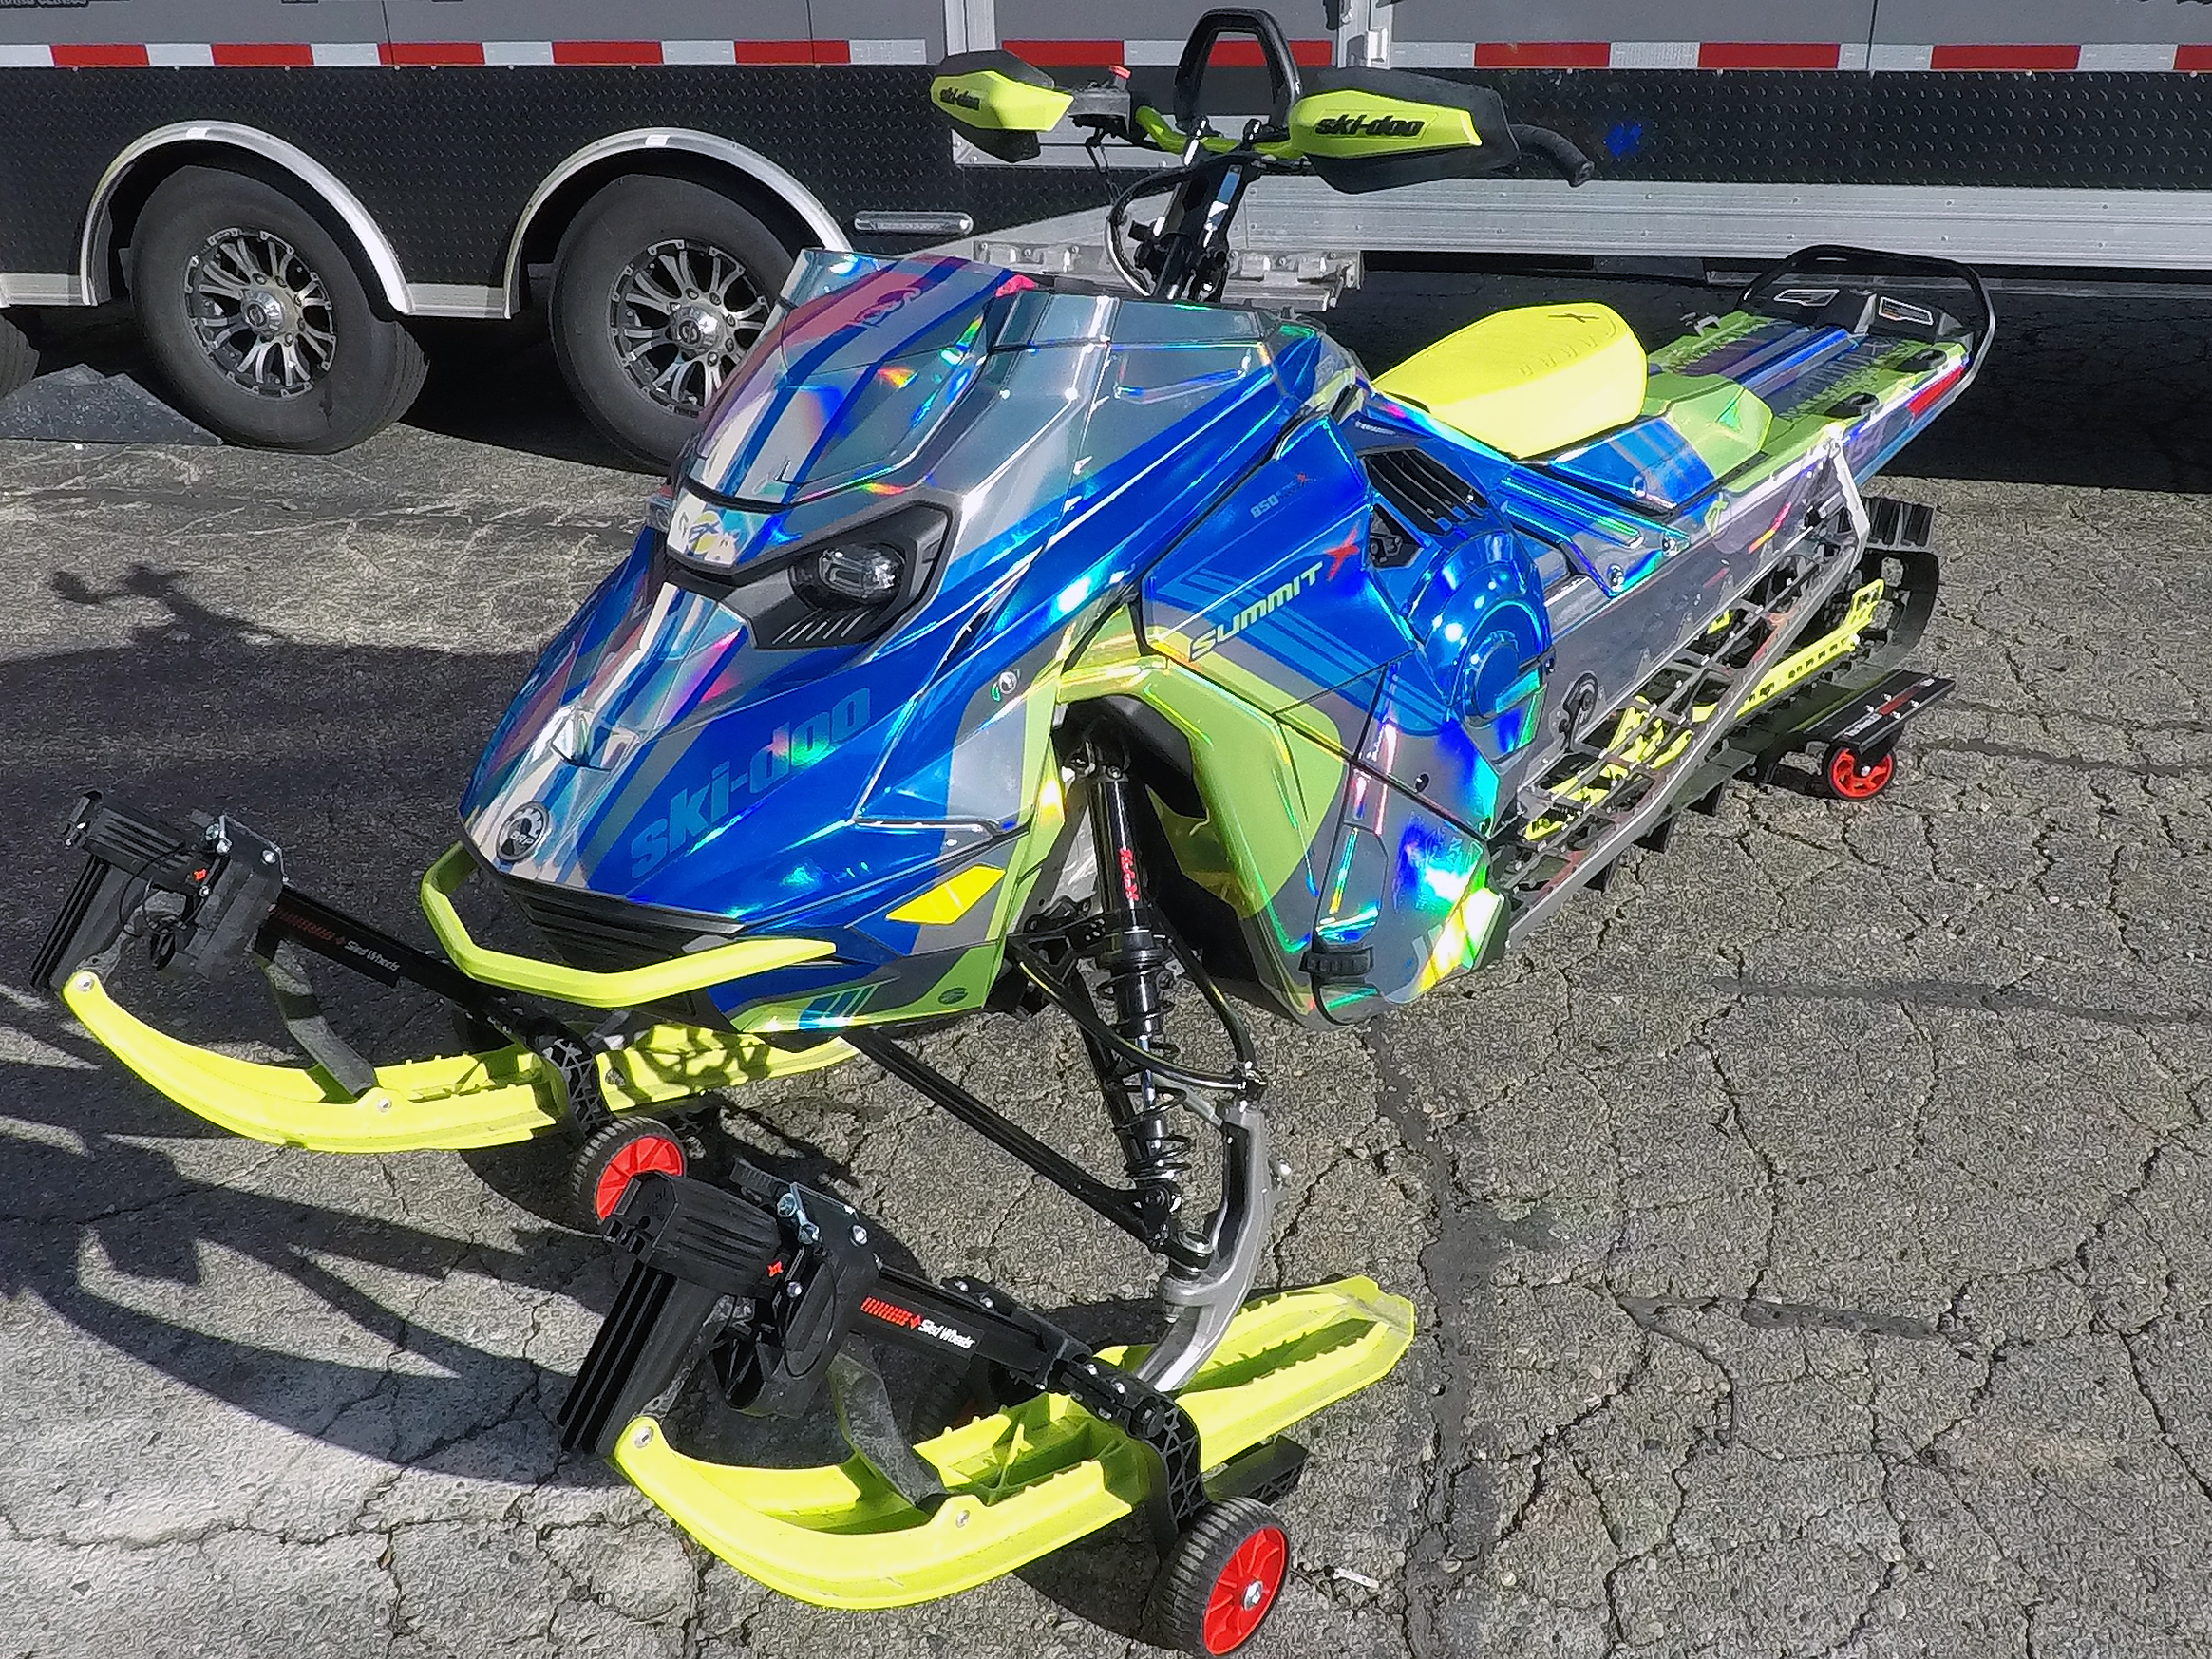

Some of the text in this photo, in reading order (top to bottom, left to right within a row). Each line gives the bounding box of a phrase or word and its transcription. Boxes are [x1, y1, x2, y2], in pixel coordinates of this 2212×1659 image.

[1315, 114, 1426, 136] ski-doo
[1250, 494, 1279, 518] 850
[1190, 560, 1323, 662] SUMMIT
[631, 687, 870, 878] ski-doo
[510, 830, 535, 845] BRP
[344, 940, 400, 971] Sled Wheels
[917, 1319, 976, 1348] Sled Wheels
